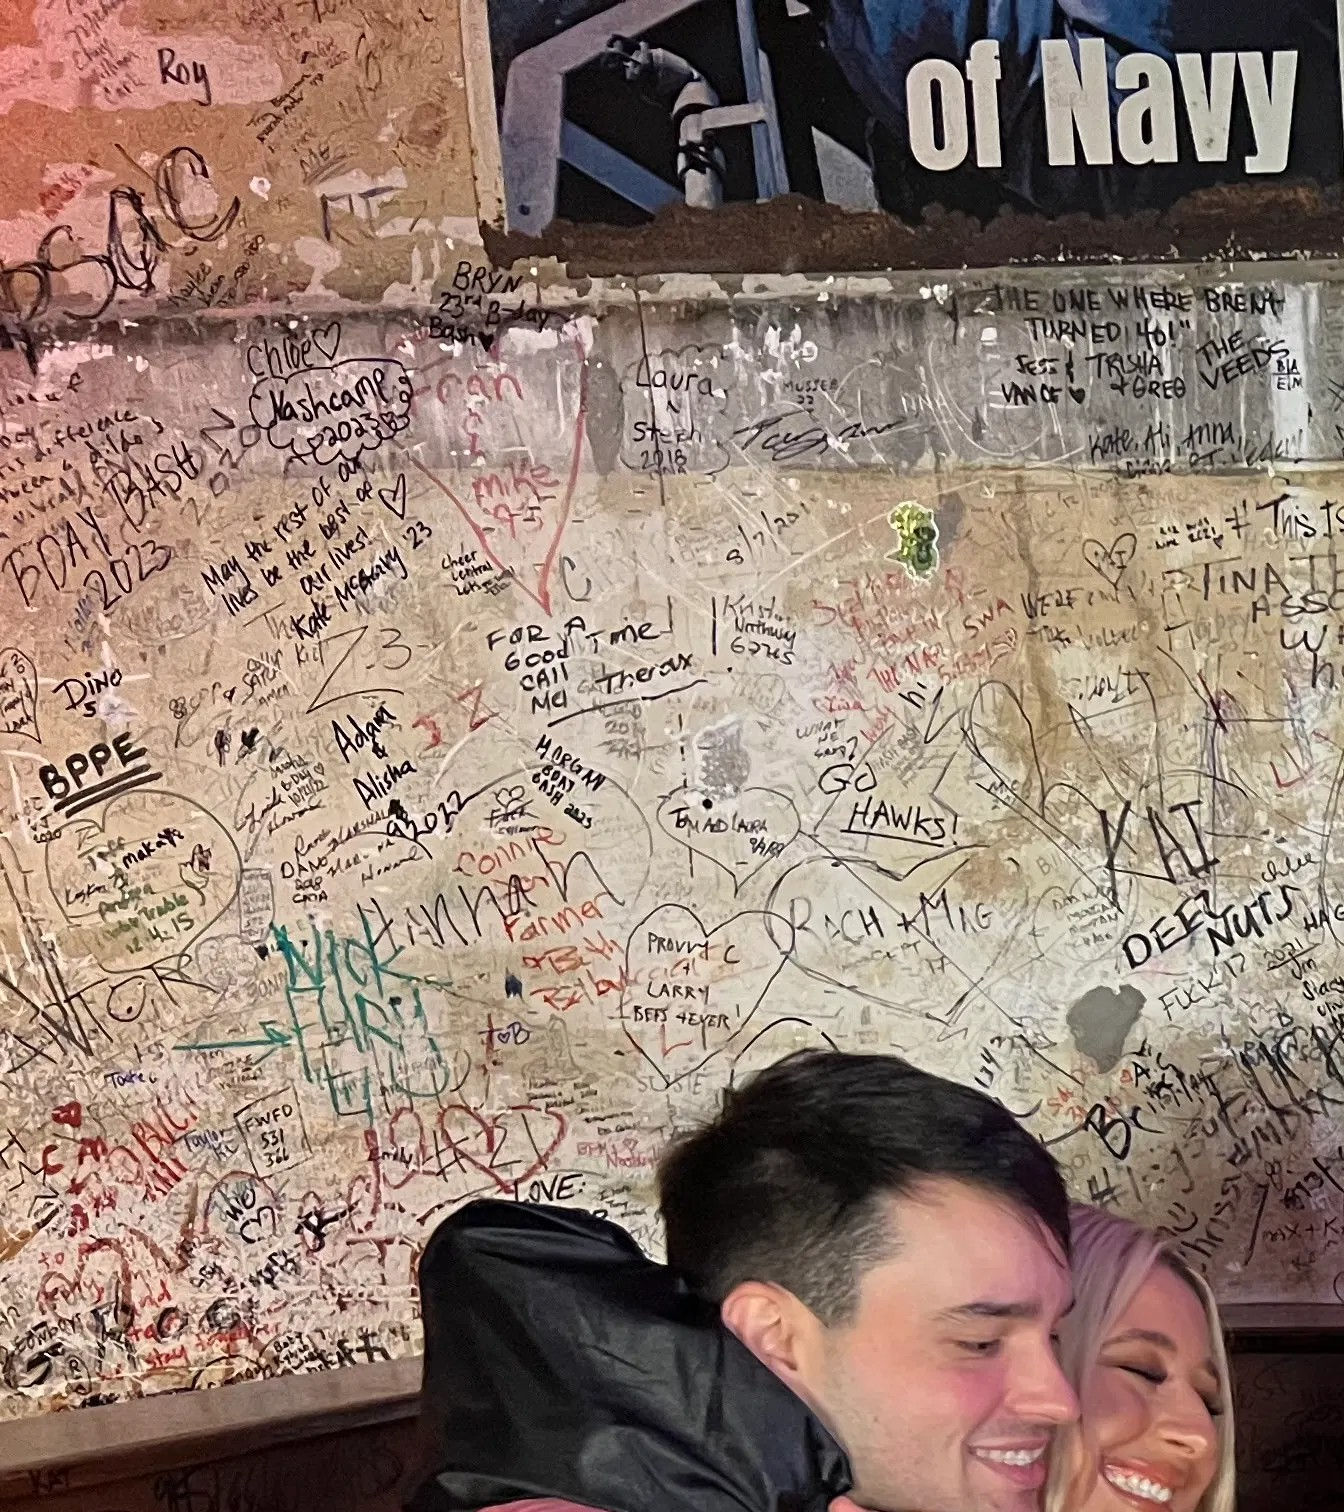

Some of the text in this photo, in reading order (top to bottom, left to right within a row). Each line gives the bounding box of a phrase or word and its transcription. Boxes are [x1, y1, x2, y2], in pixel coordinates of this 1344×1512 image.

[158, 48, 211, 104] Roy
[906, 38, 1298, 174] of Navy
[1052, 287, 1101, 313] ONE
[1108, 286, 1193, 313] WHERE
[1196, 329, 1243, 366] THE
[85, 540, 171, 610] 2023
[201, 555, 251, 595] May
[286, 540, 316, 570] the
[486, 625, 551, 652] FOR
[38, 729, 149, 801] BPPE
